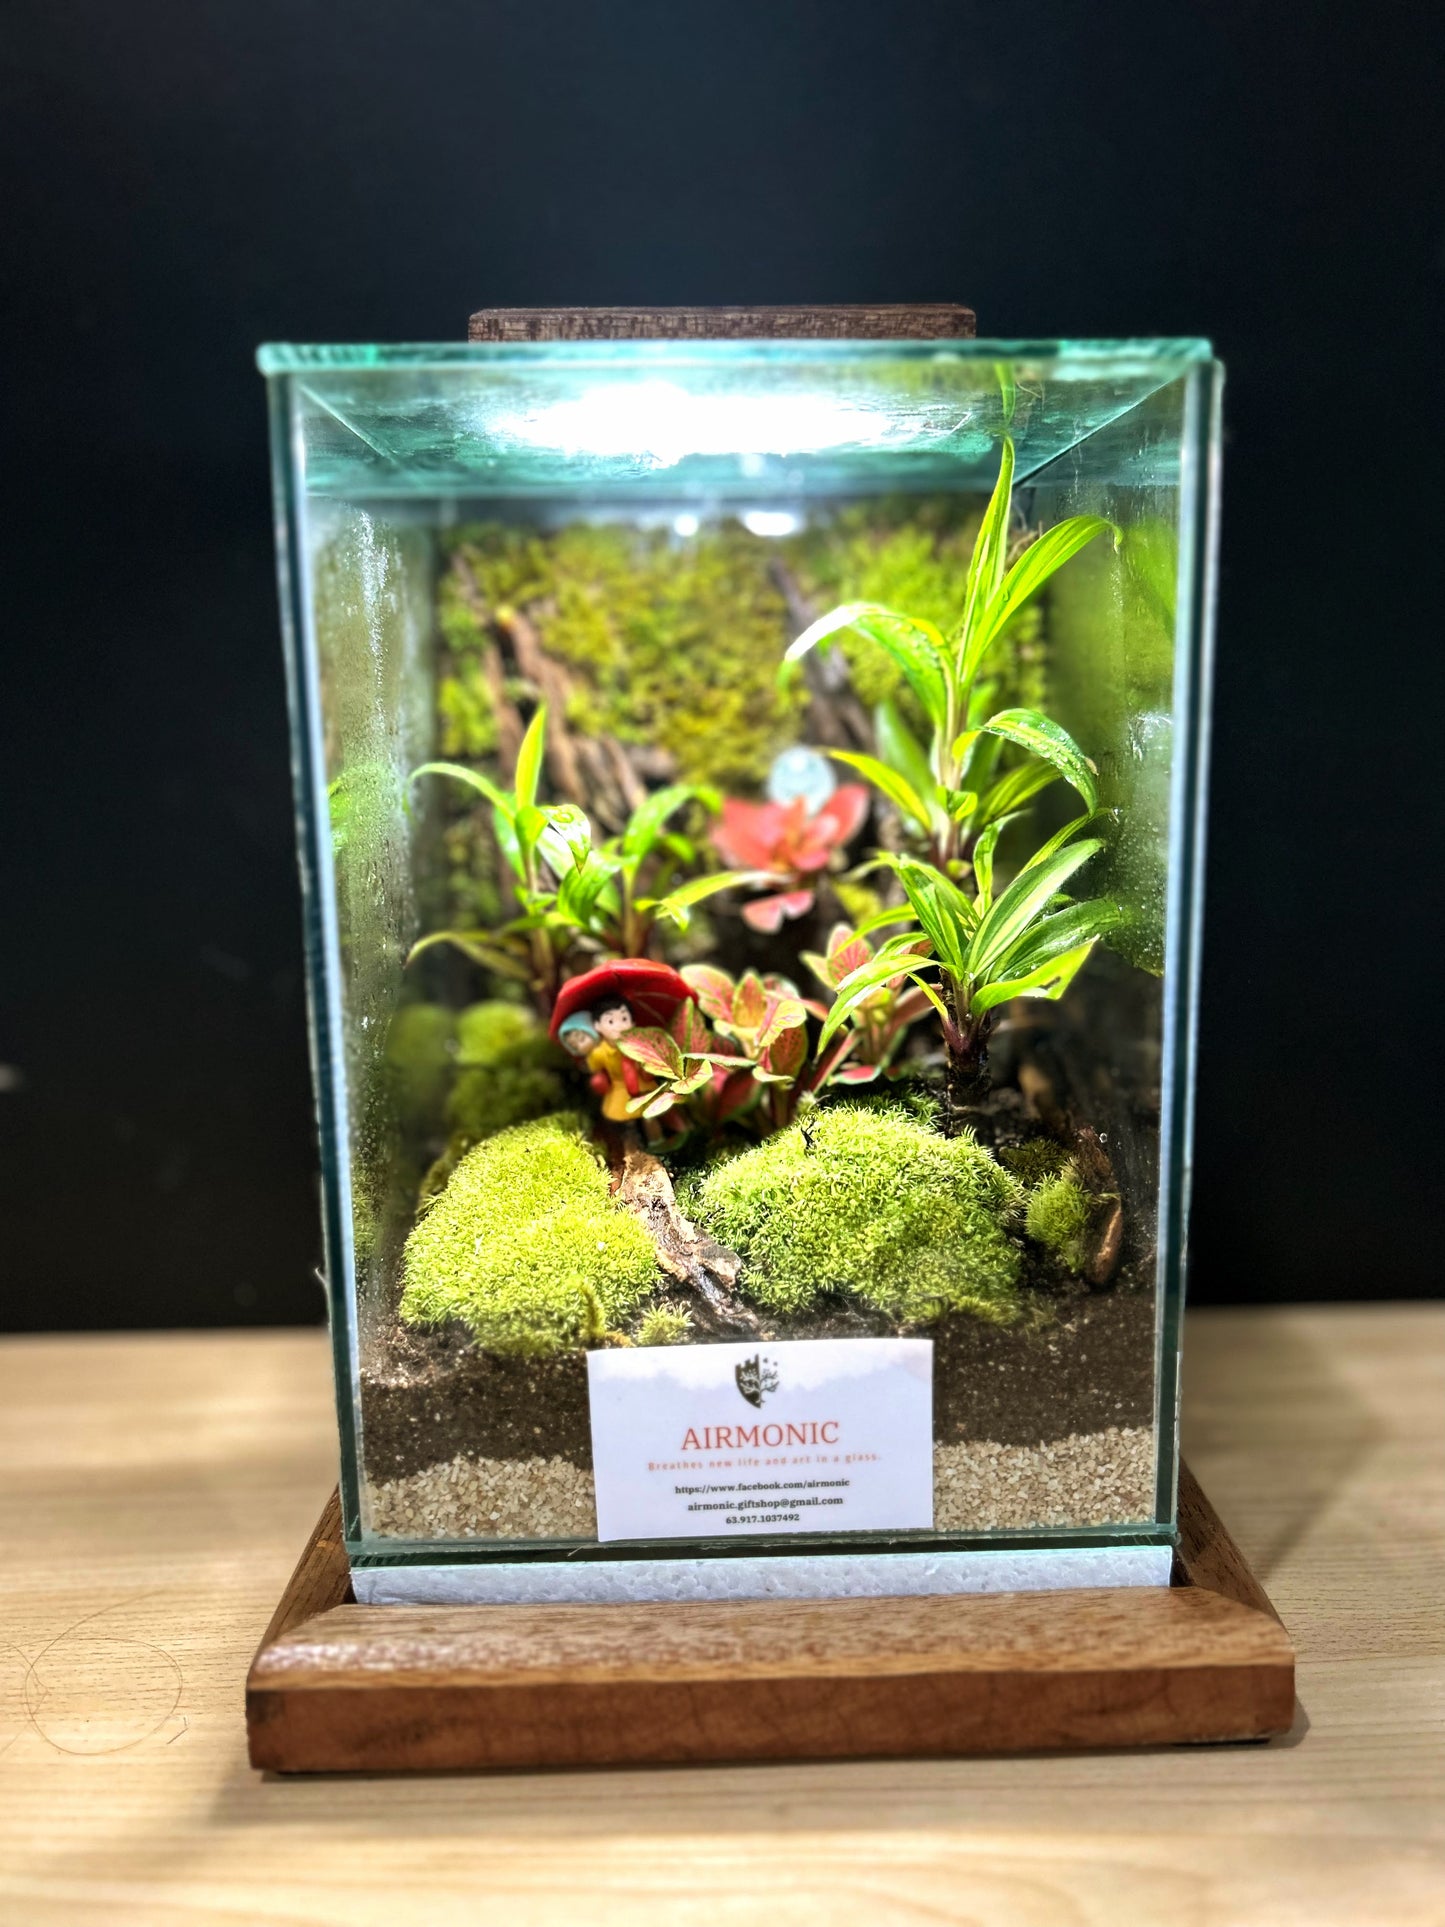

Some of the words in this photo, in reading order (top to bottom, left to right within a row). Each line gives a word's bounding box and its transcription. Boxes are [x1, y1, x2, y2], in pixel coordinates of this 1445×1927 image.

[681, 1421, 840, 1451] AIRMONIC
[648, 1460, 703, 1472] Breathes
[709, 1460, 733, 1468] new
[738, 1457, 760, 1467] life
[765, 1456, 787, 1466] and
[792, 1455, 811, 1465] art
[816, 1454, 827, 1464] in
[845, 1453, 882, 1464] glass.
[675, 1479, 850, 1495] https://www.facebook.com/airmonic
[687, 1496, 844, 1512] airmonic.giftshop@gmail.com
[726, 1514, 800, 1525] 63.917.1037492
